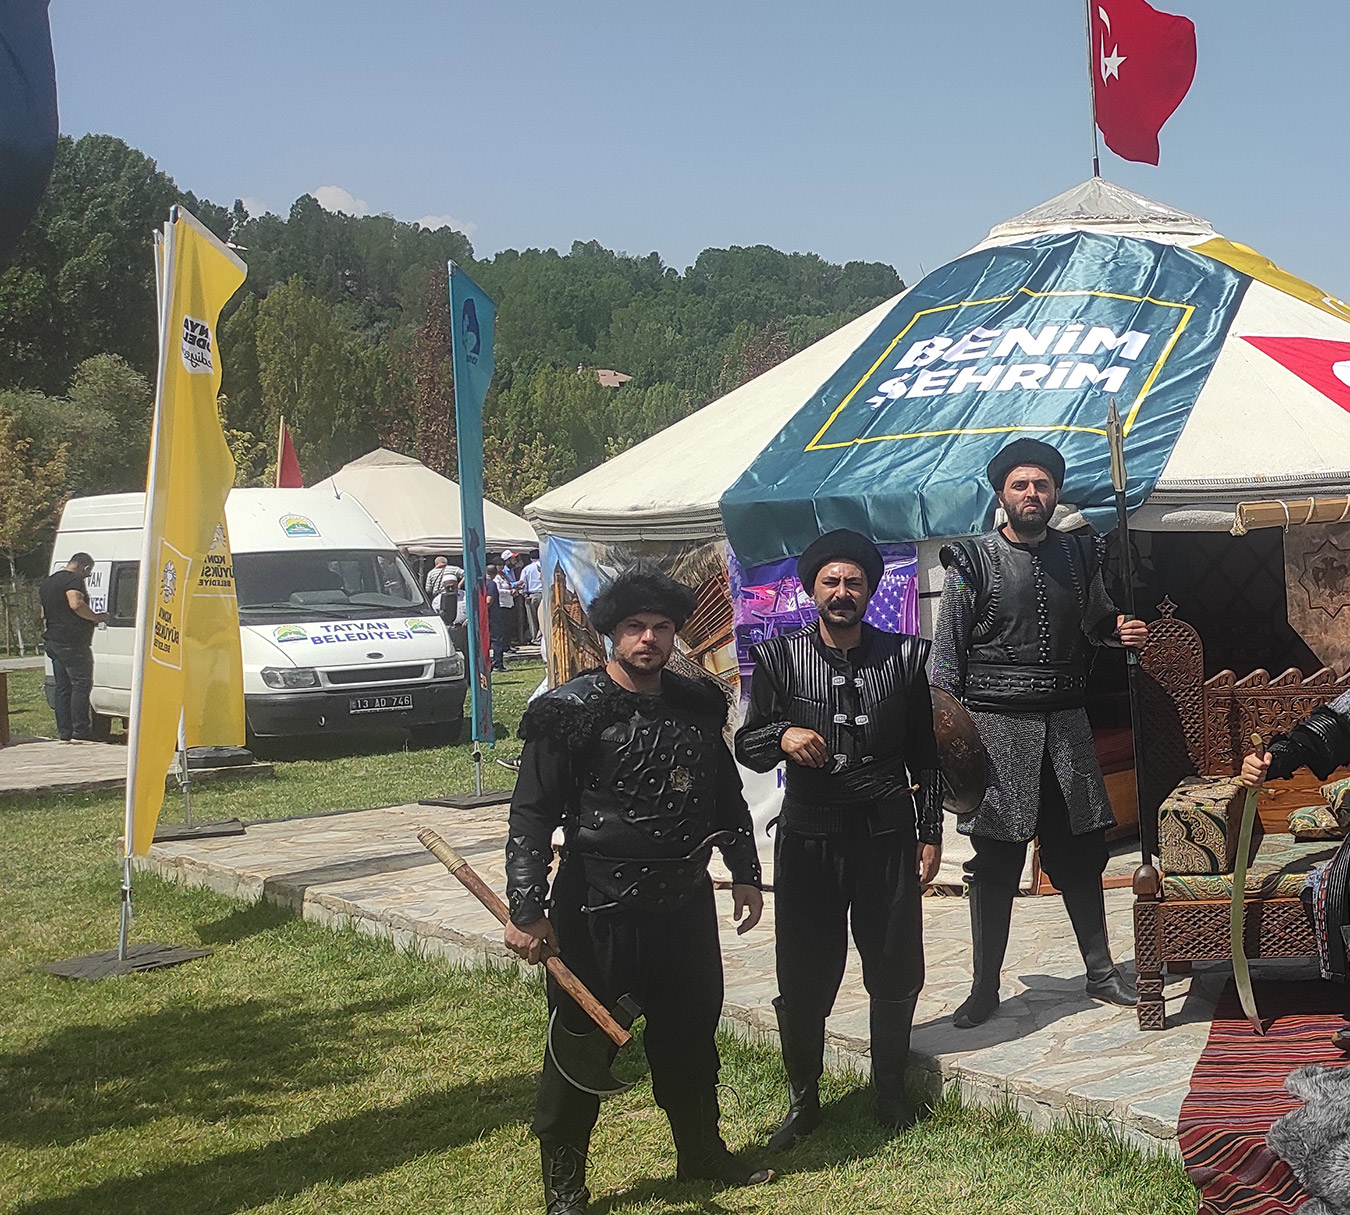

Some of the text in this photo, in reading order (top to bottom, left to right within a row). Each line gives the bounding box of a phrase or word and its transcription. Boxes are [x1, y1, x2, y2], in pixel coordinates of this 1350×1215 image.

[320, 622, 390, 633] TATVAN
[310, 629, 414, 645] BELEDİYESİ
[357, 696, 410, 708] 13 AD 746
